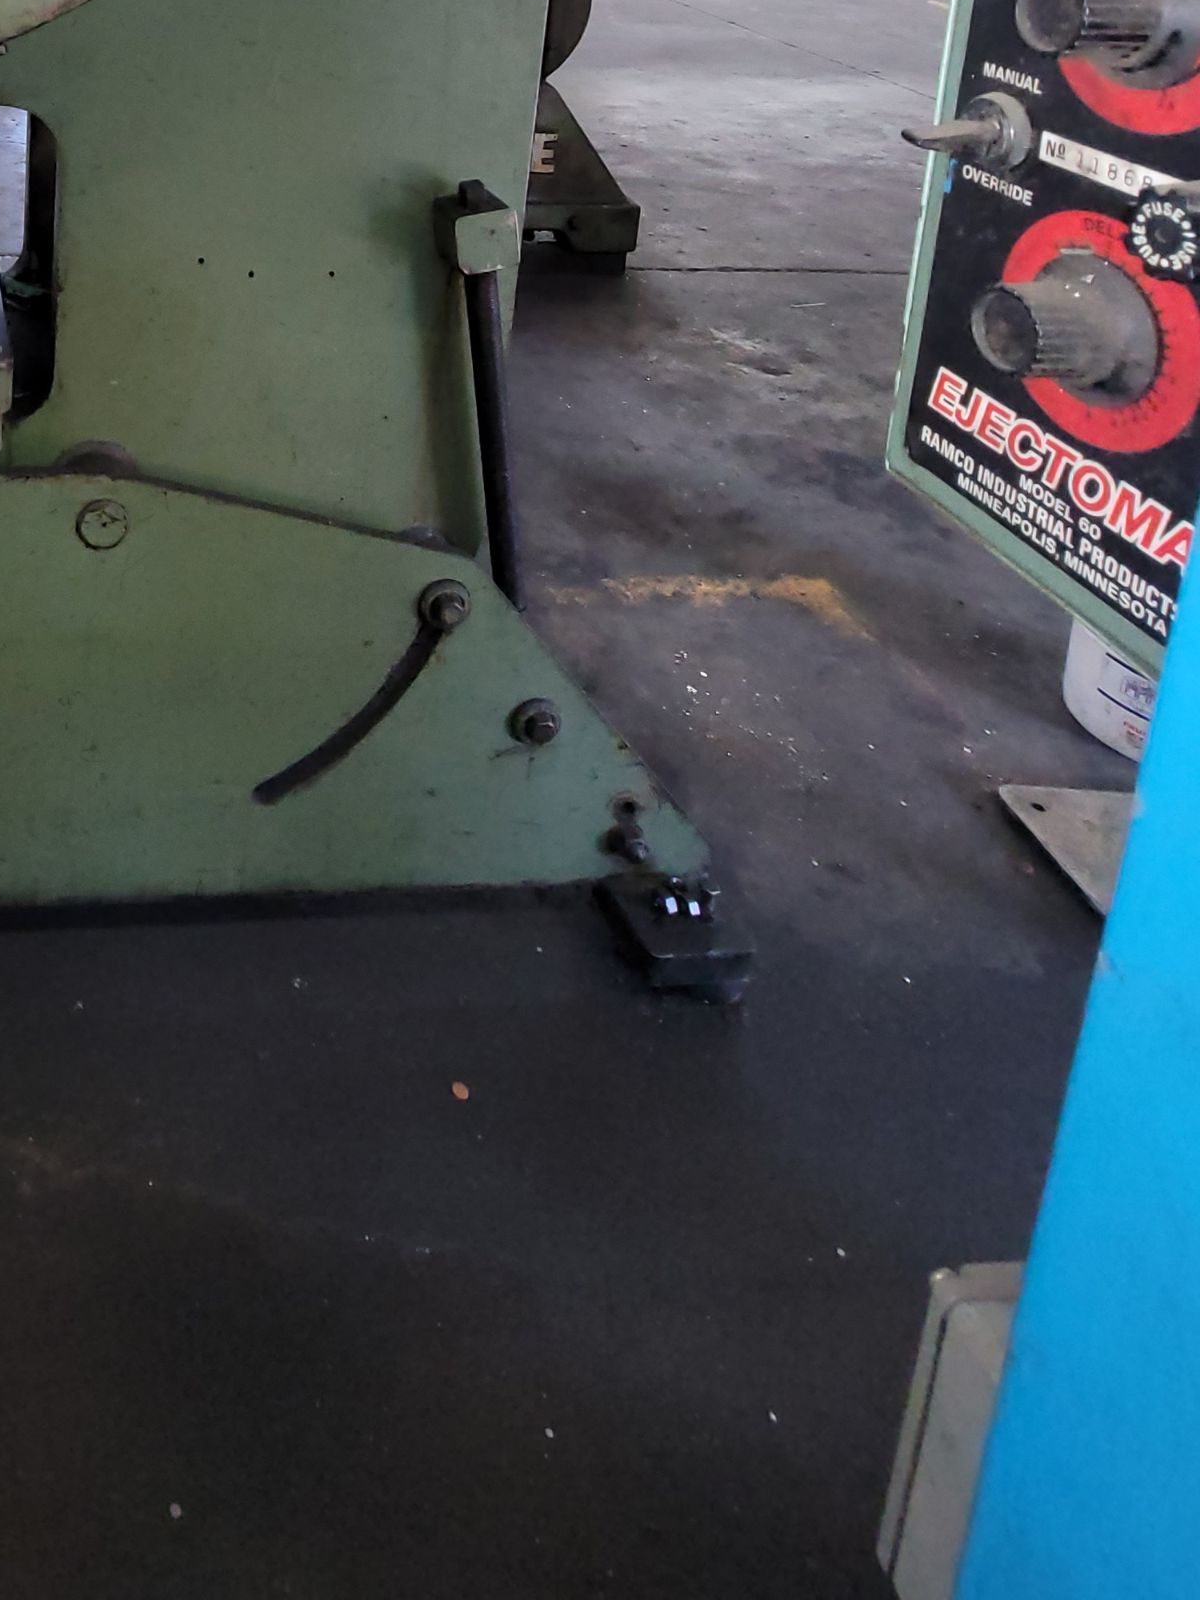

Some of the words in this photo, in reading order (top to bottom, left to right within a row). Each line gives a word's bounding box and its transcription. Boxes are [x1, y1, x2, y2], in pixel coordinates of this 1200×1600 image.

[983, 61, 1043, 95] MANUAL
[962, 164, 1034, 206] OVERRIDE
[1142, 201, 1186, 223] FUSE
[1083, 217, 1118, 240] DEL
[921, 425, 975, 475] RAMCO
[977, 464, 1074, 549] INDUSTRIAL
[927, 365, 1196, 577] EJECTOMA
[1019, 474, 1074, 524] MODEL
[1078, 517, 1102, 541] 60
[957, 472, 1060, 561] MINNEAPOLIS,
[1064, 550, 1167, 638] MINNESOTA
